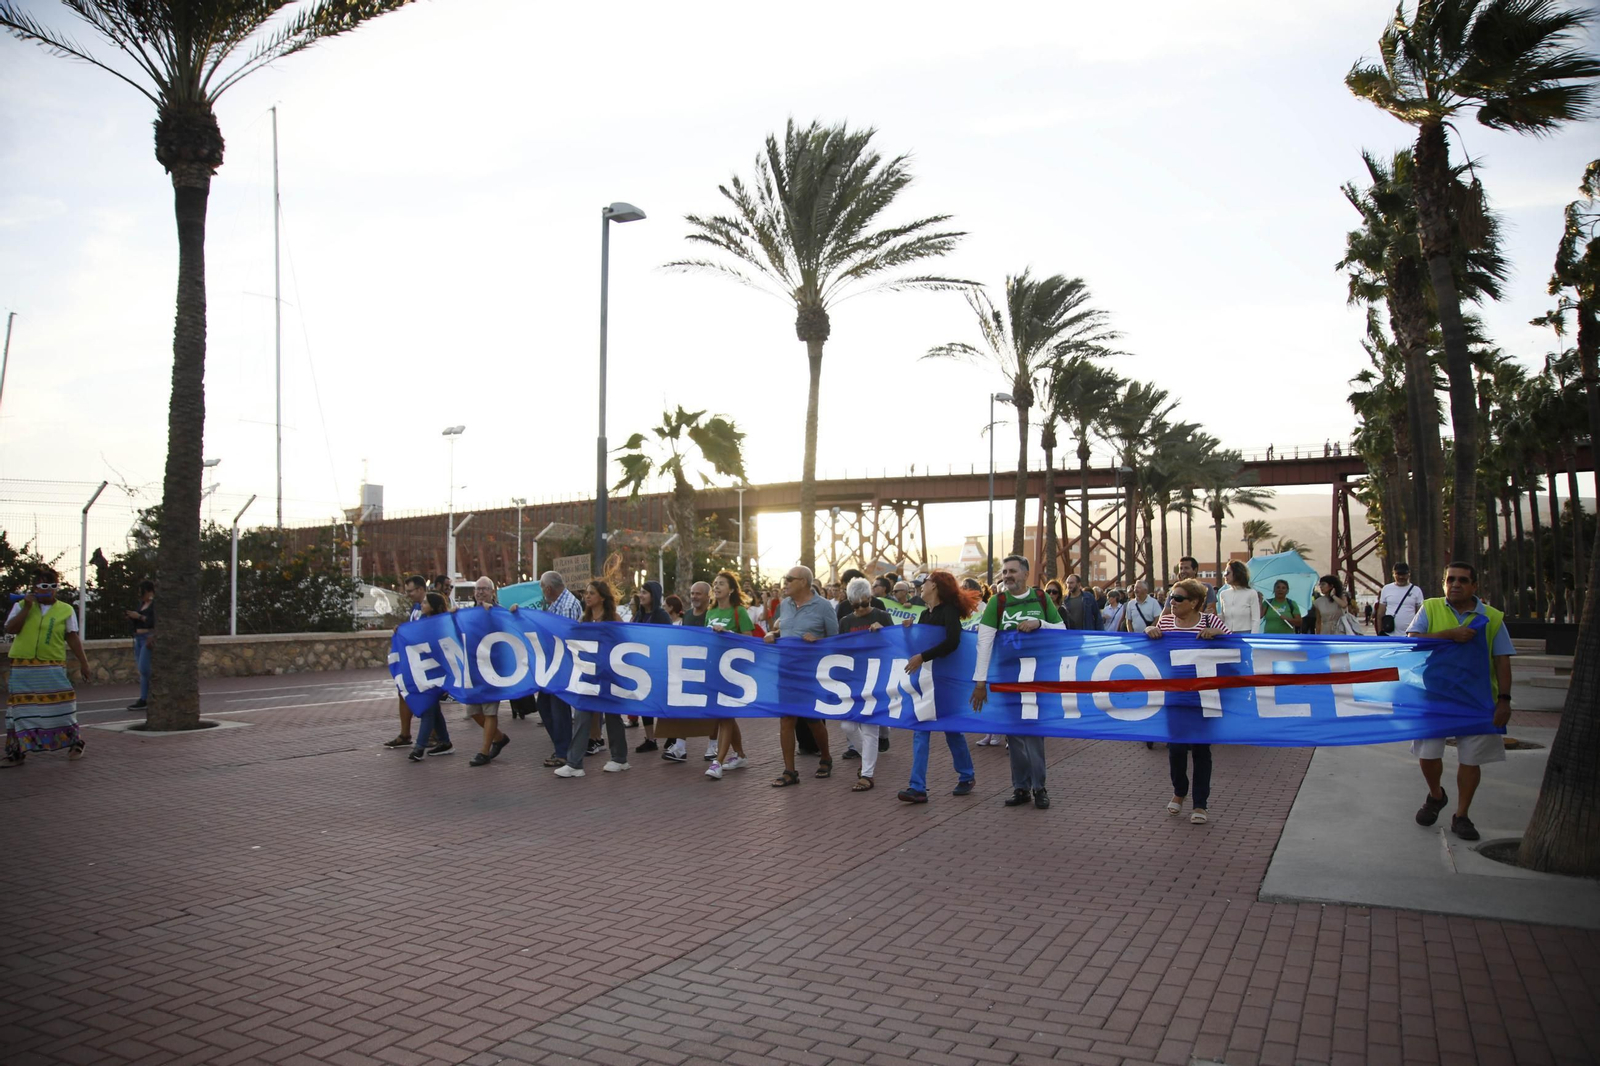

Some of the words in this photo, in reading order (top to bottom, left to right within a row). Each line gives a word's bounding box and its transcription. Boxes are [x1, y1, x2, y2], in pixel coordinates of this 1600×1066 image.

[886, 607, 917, 620] cinos
[814, 654, 937, 721] SIN
[1018, 648, 1393, 721] HOTEL
